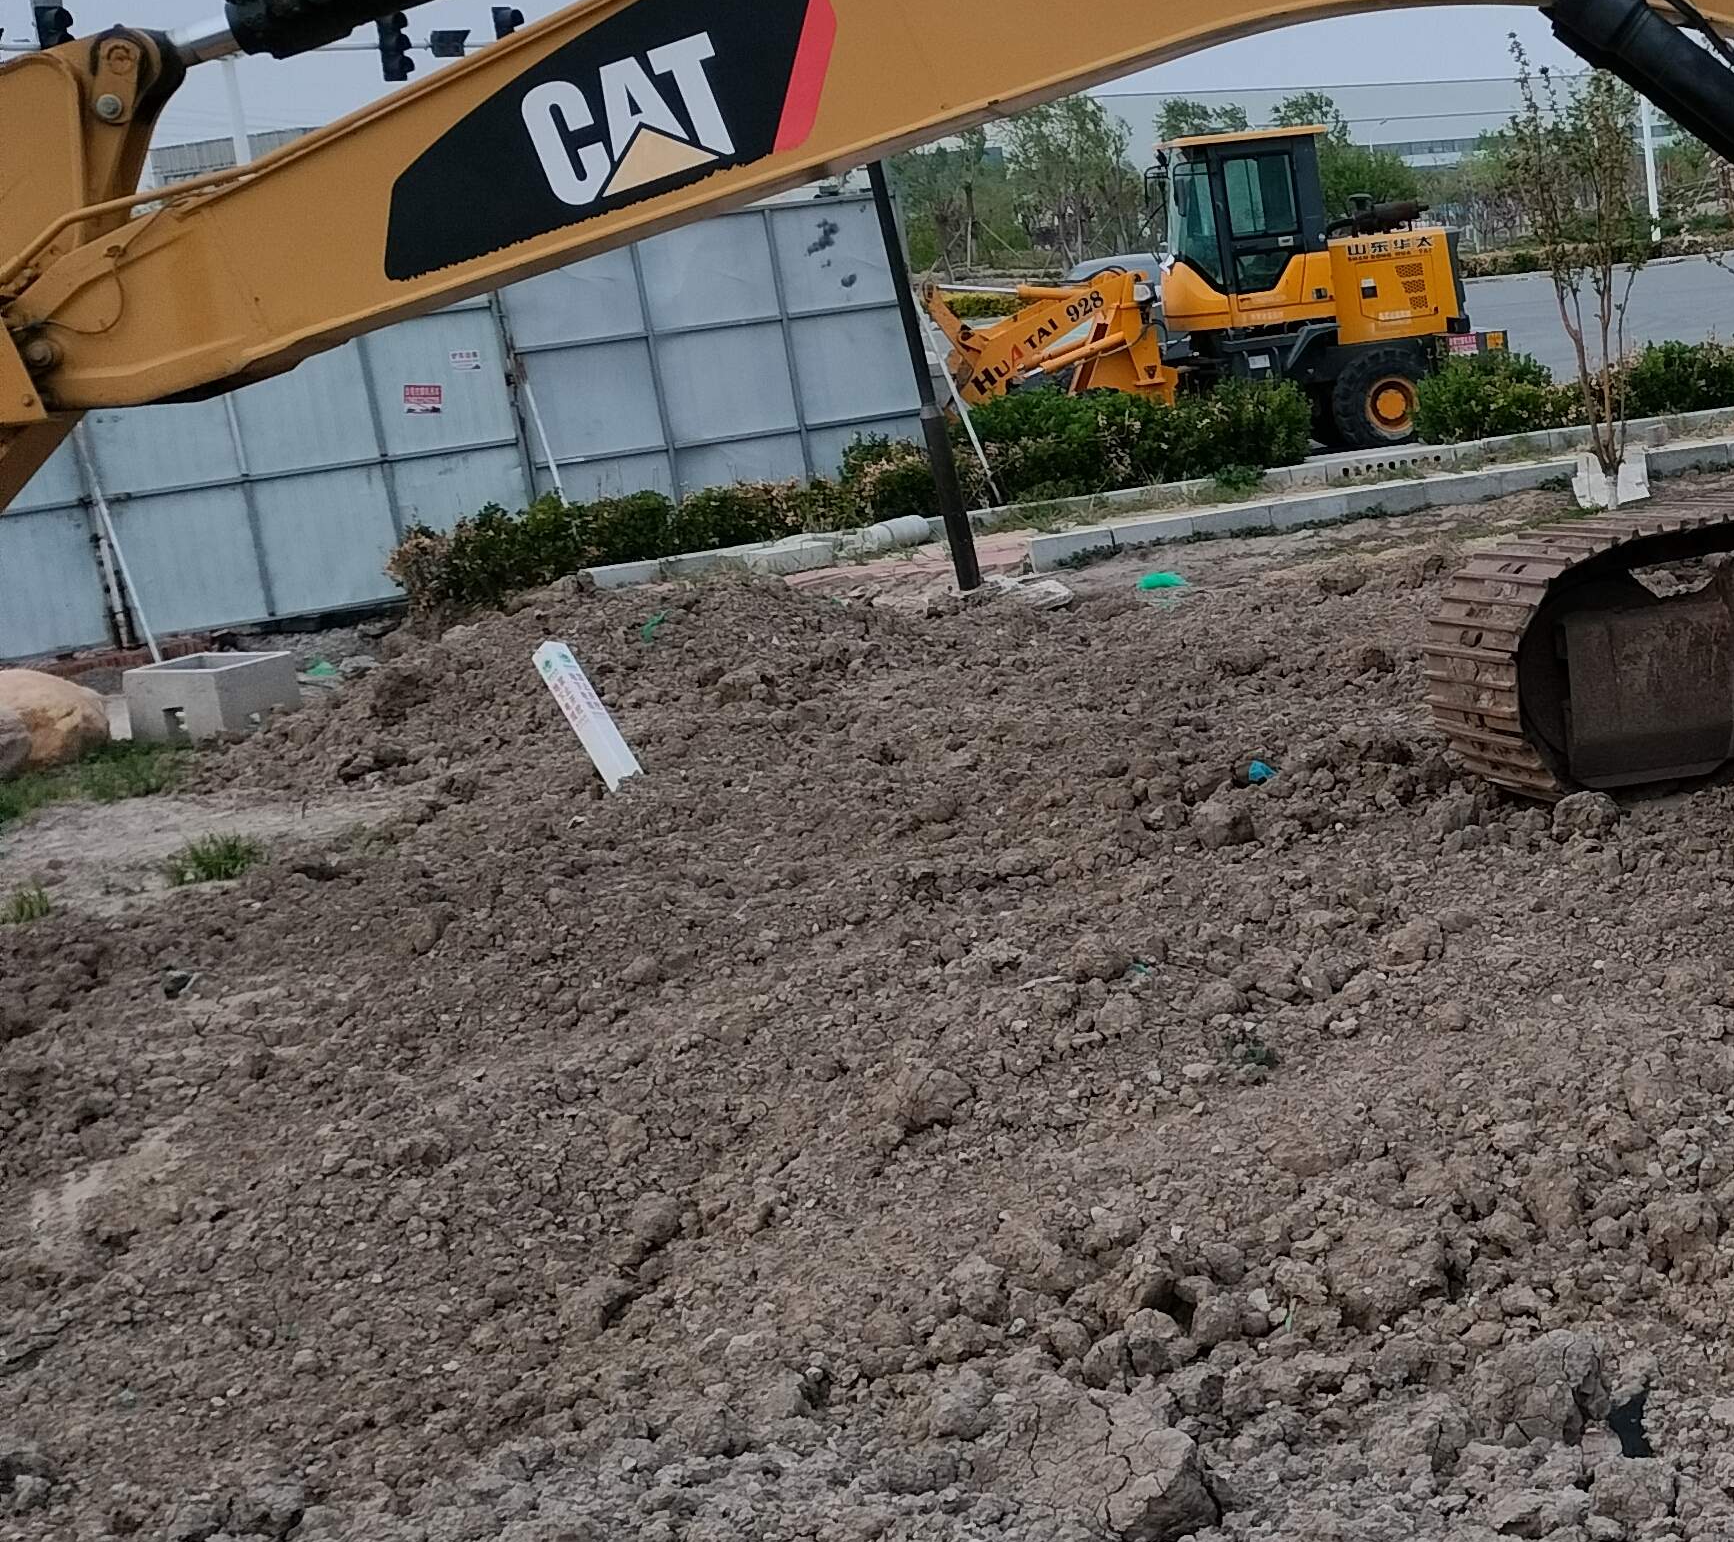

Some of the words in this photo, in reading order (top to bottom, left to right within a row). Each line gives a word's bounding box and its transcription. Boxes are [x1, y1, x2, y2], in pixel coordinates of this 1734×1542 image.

[520, 31, 736, 206] CAT
[1347, 236, 1433, 256] 山东华太
[1065, 290, 1104, 322] 928
